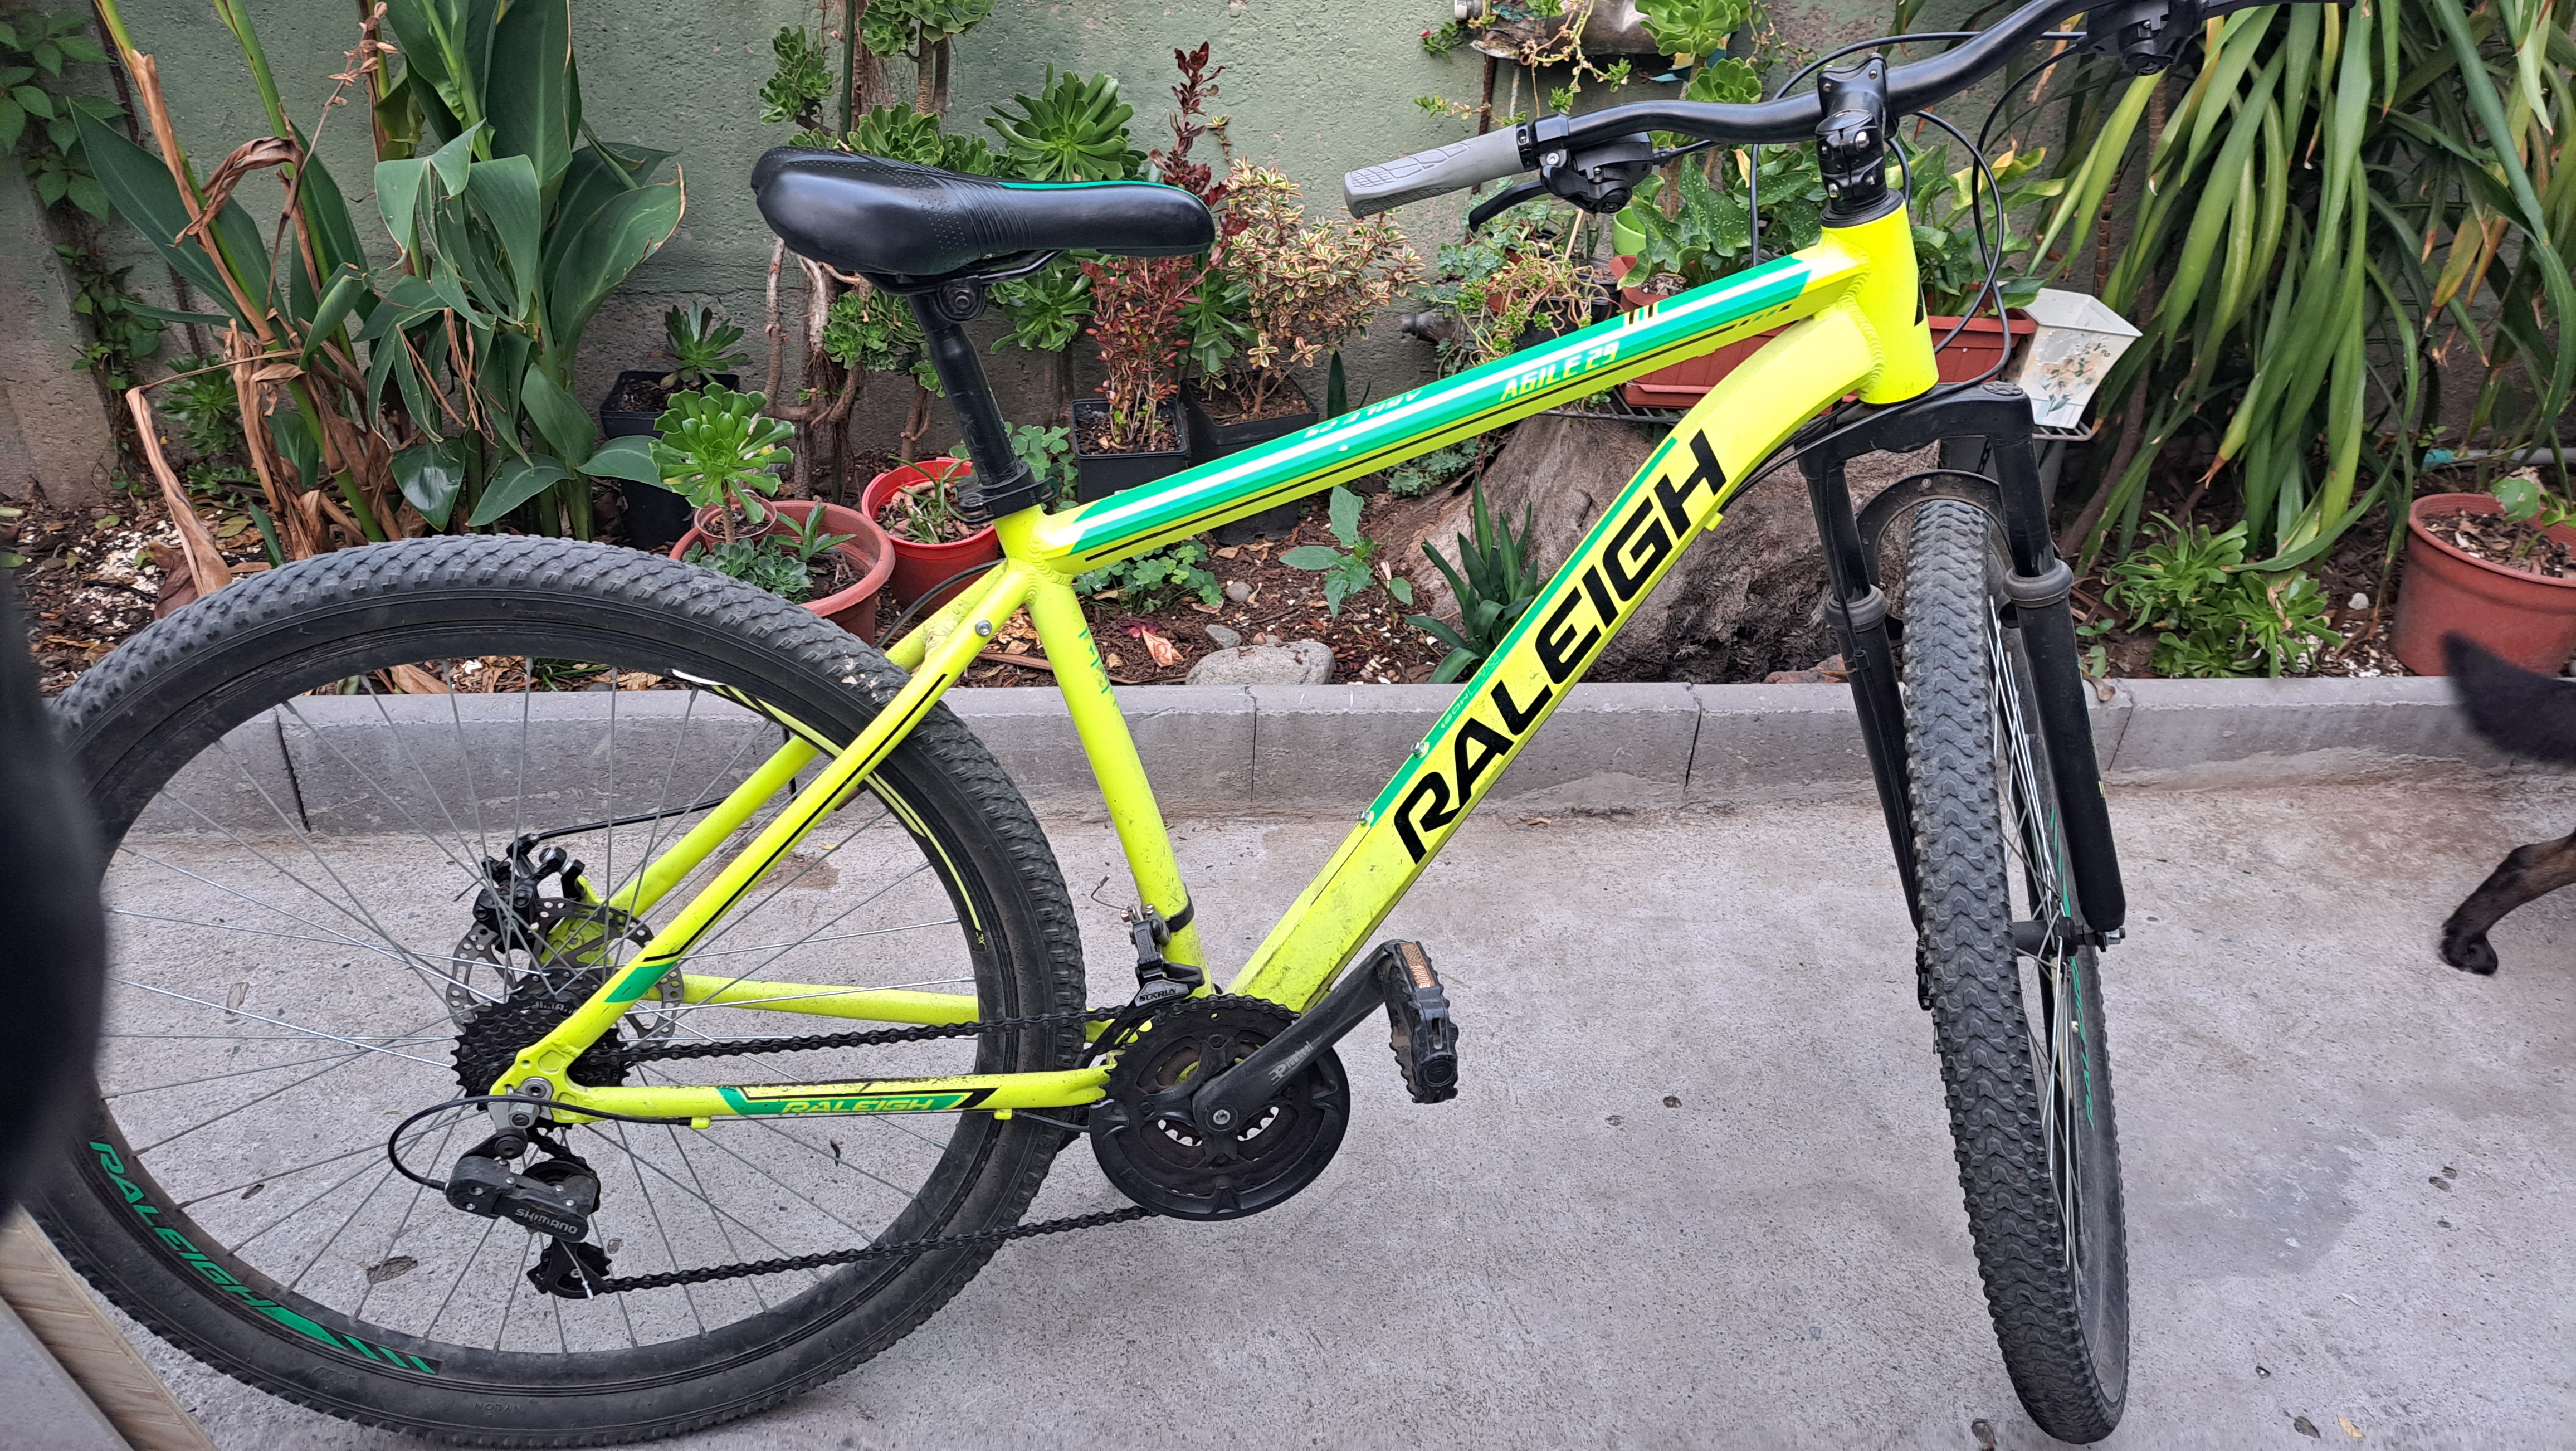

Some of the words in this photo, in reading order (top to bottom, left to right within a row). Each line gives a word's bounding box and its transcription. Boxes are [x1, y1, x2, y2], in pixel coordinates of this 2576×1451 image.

[1500, 353, 1583, 402] AGILE
[1585, 340, 1619, 370] 29
[1393, 428, 1727, 865] RALEIGH
[1139, 987, 1177, 1002] SUNRUN
[780, 1098, 935, 1114] RALEIGH
[89, 1141, 277, 1308] RALEIGH
[515, 1206, 578, 1235] SHIMANO
